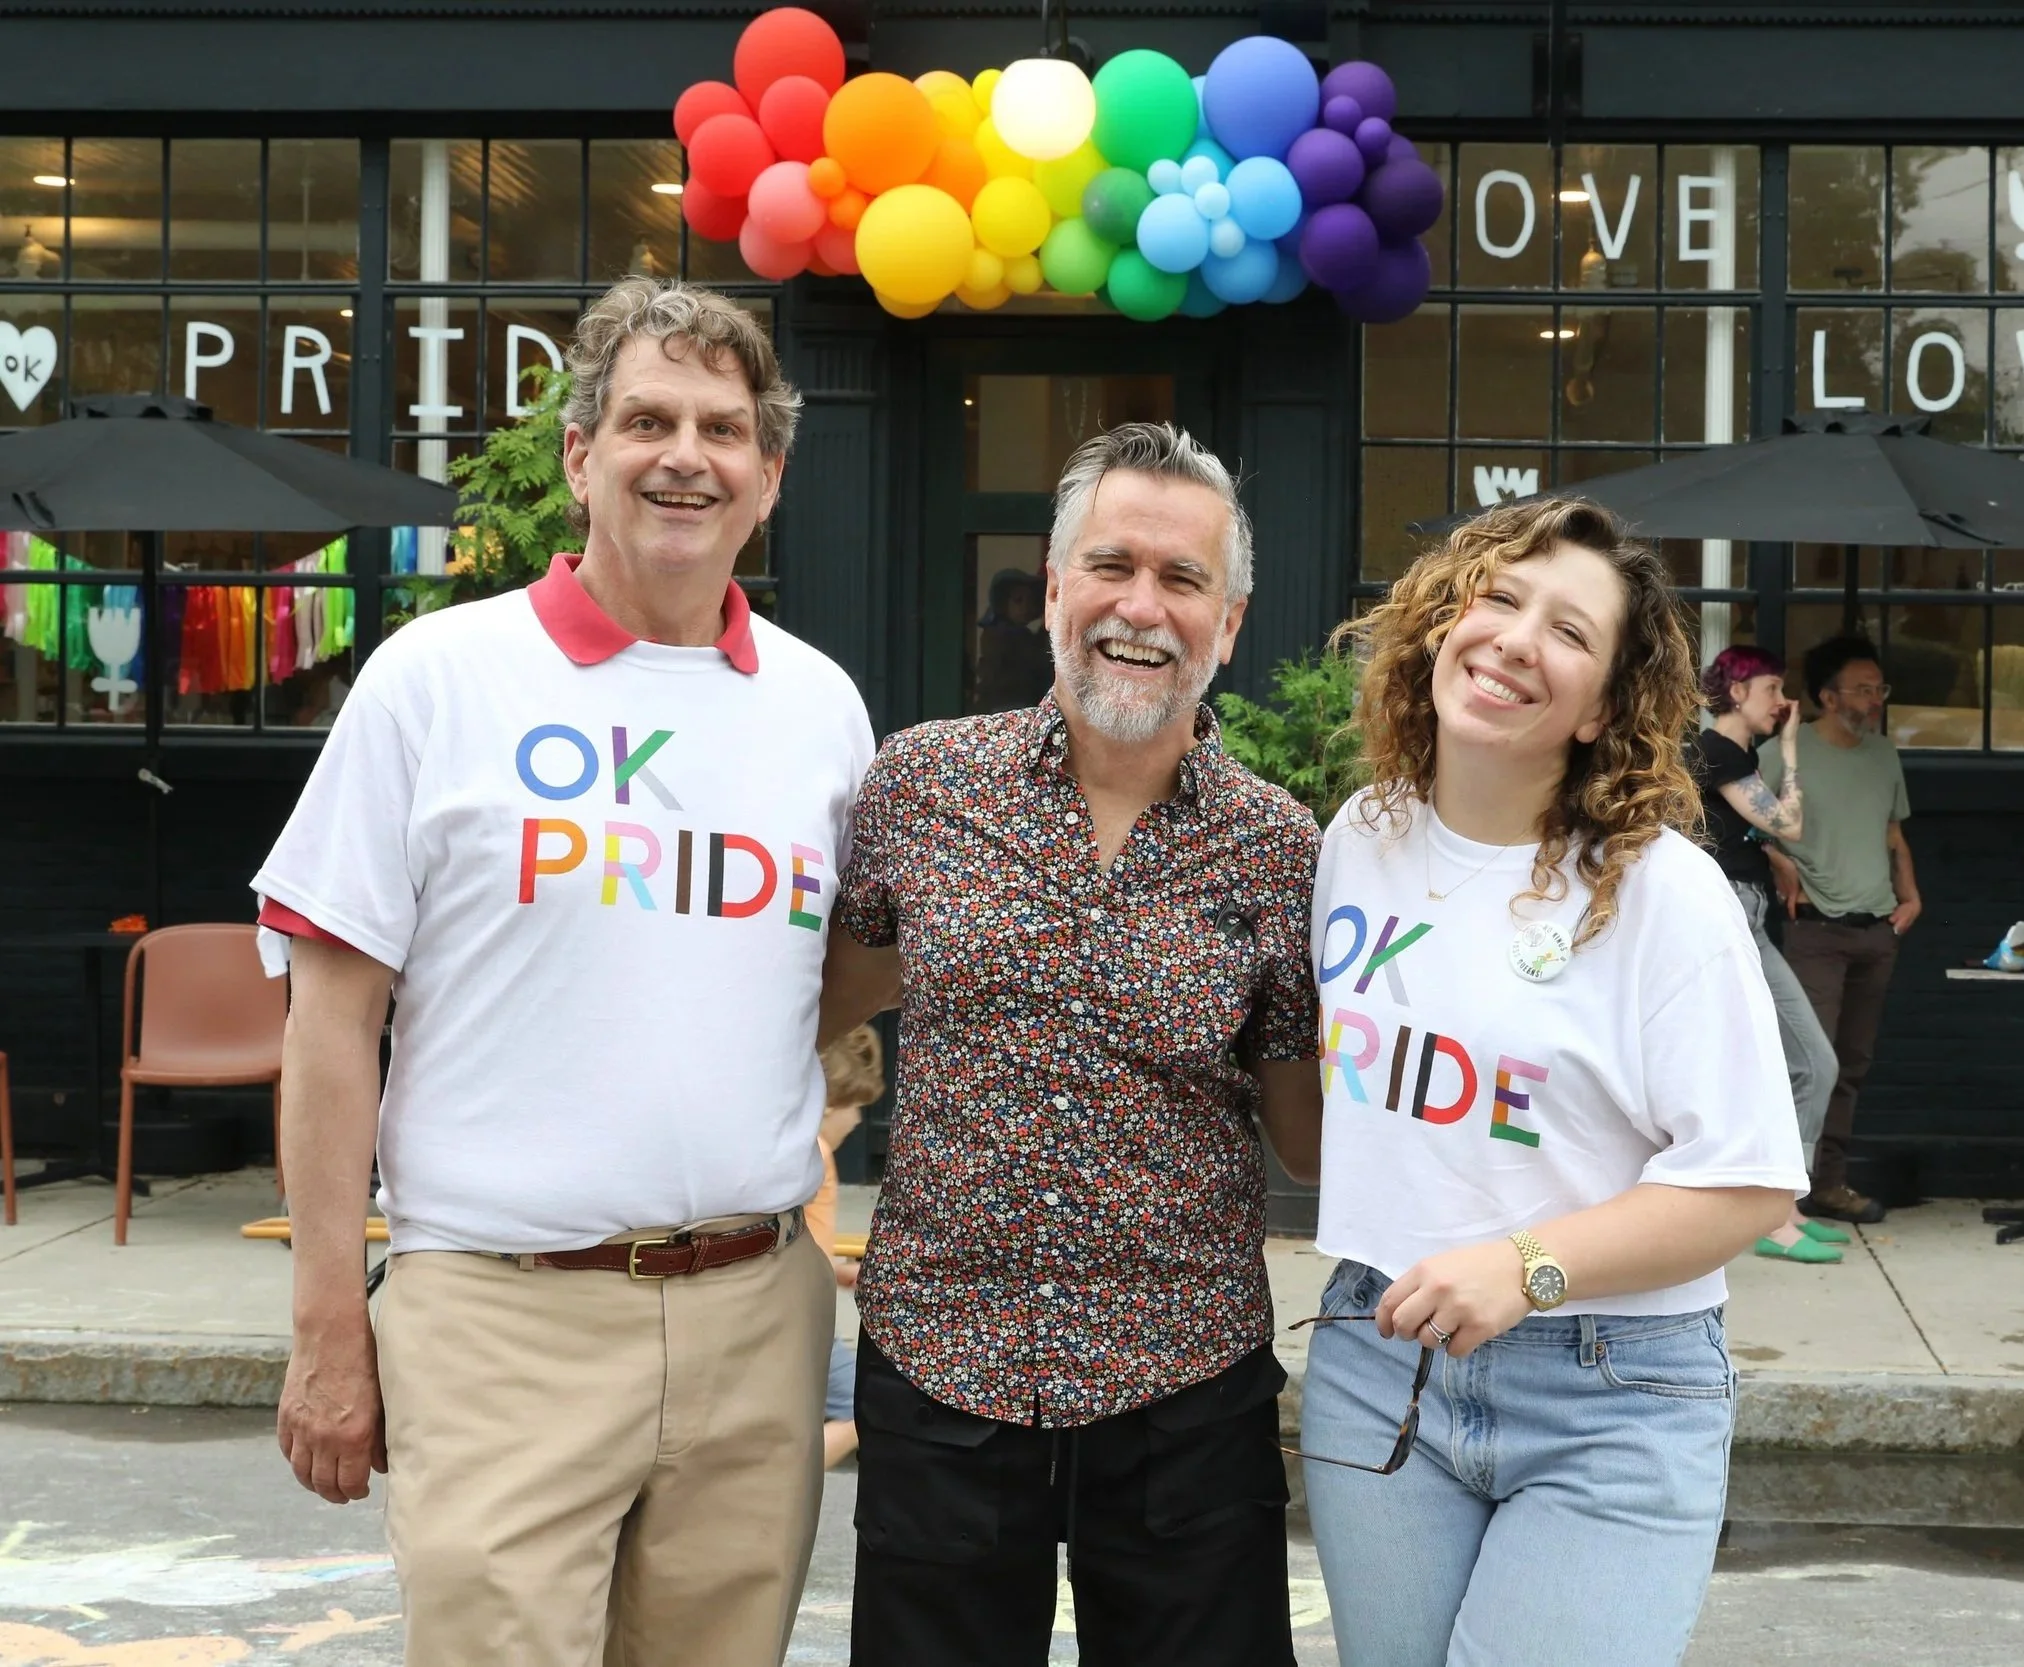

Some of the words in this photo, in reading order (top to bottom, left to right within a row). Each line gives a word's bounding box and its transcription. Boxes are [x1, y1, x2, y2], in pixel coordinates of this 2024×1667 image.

[1475, 169, 1726, 261] OVE
[5, 355, 42, 382] OK
[185, 321, 564, 417] PRID
[1813, 330, 2024, 412] LO
[515, 724, 684, 811] OK
[518, 818, 824, 932] PRIDE
[1319, 905, 1434, 1007] OK
[1319, 1004, 1549, 1148] RIDE
